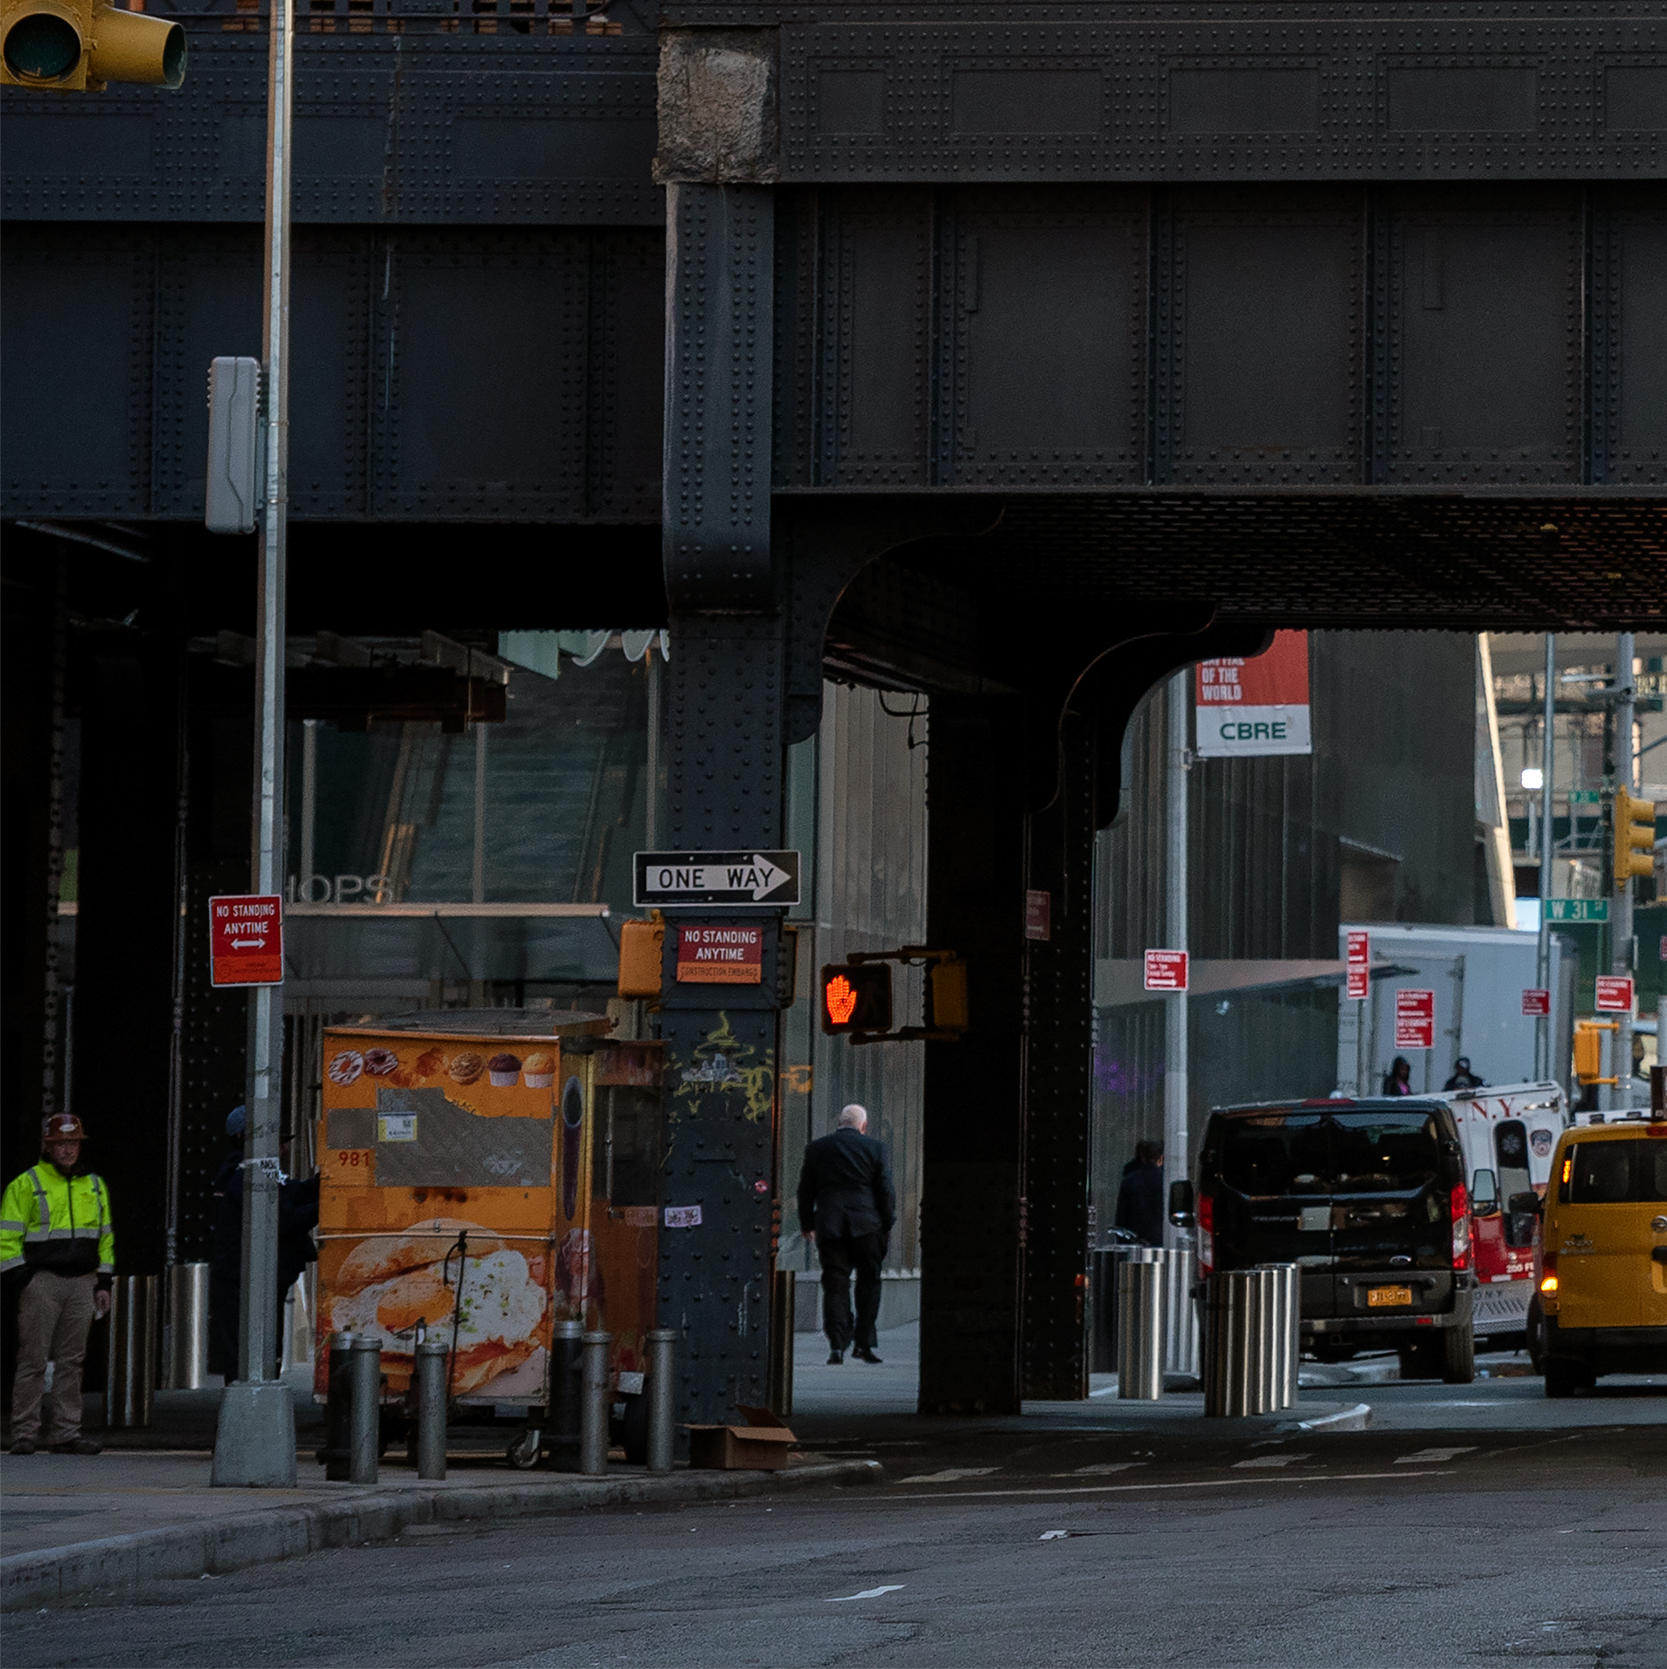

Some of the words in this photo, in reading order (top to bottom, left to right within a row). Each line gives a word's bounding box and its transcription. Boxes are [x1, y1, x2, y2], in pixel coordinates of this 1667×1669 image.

[1202, 668, 1215, 683] OF
[1218, 668, 1239, 683] THE
[1202, 685, 1242, 701] WORLD
[1220, 722, 1287, 740] CBRE
[659, 868, 705, 888] ONE
[727, 867, 775, 888] WAY
[216, 906, 229, 917] NO
[232, 904, 275, 917] STANDING
[1551, 901, 1565, 919] W
[1571, 901, 1588, 919] 31
[224, 921, 269, 934] ANYTIME
[684, 930, 700, 942] NO
[702, 931, 757, 944] STANDING
[695, 948, 744, 961] ANYTIME
[339, 1152, 369, 1167] 981
